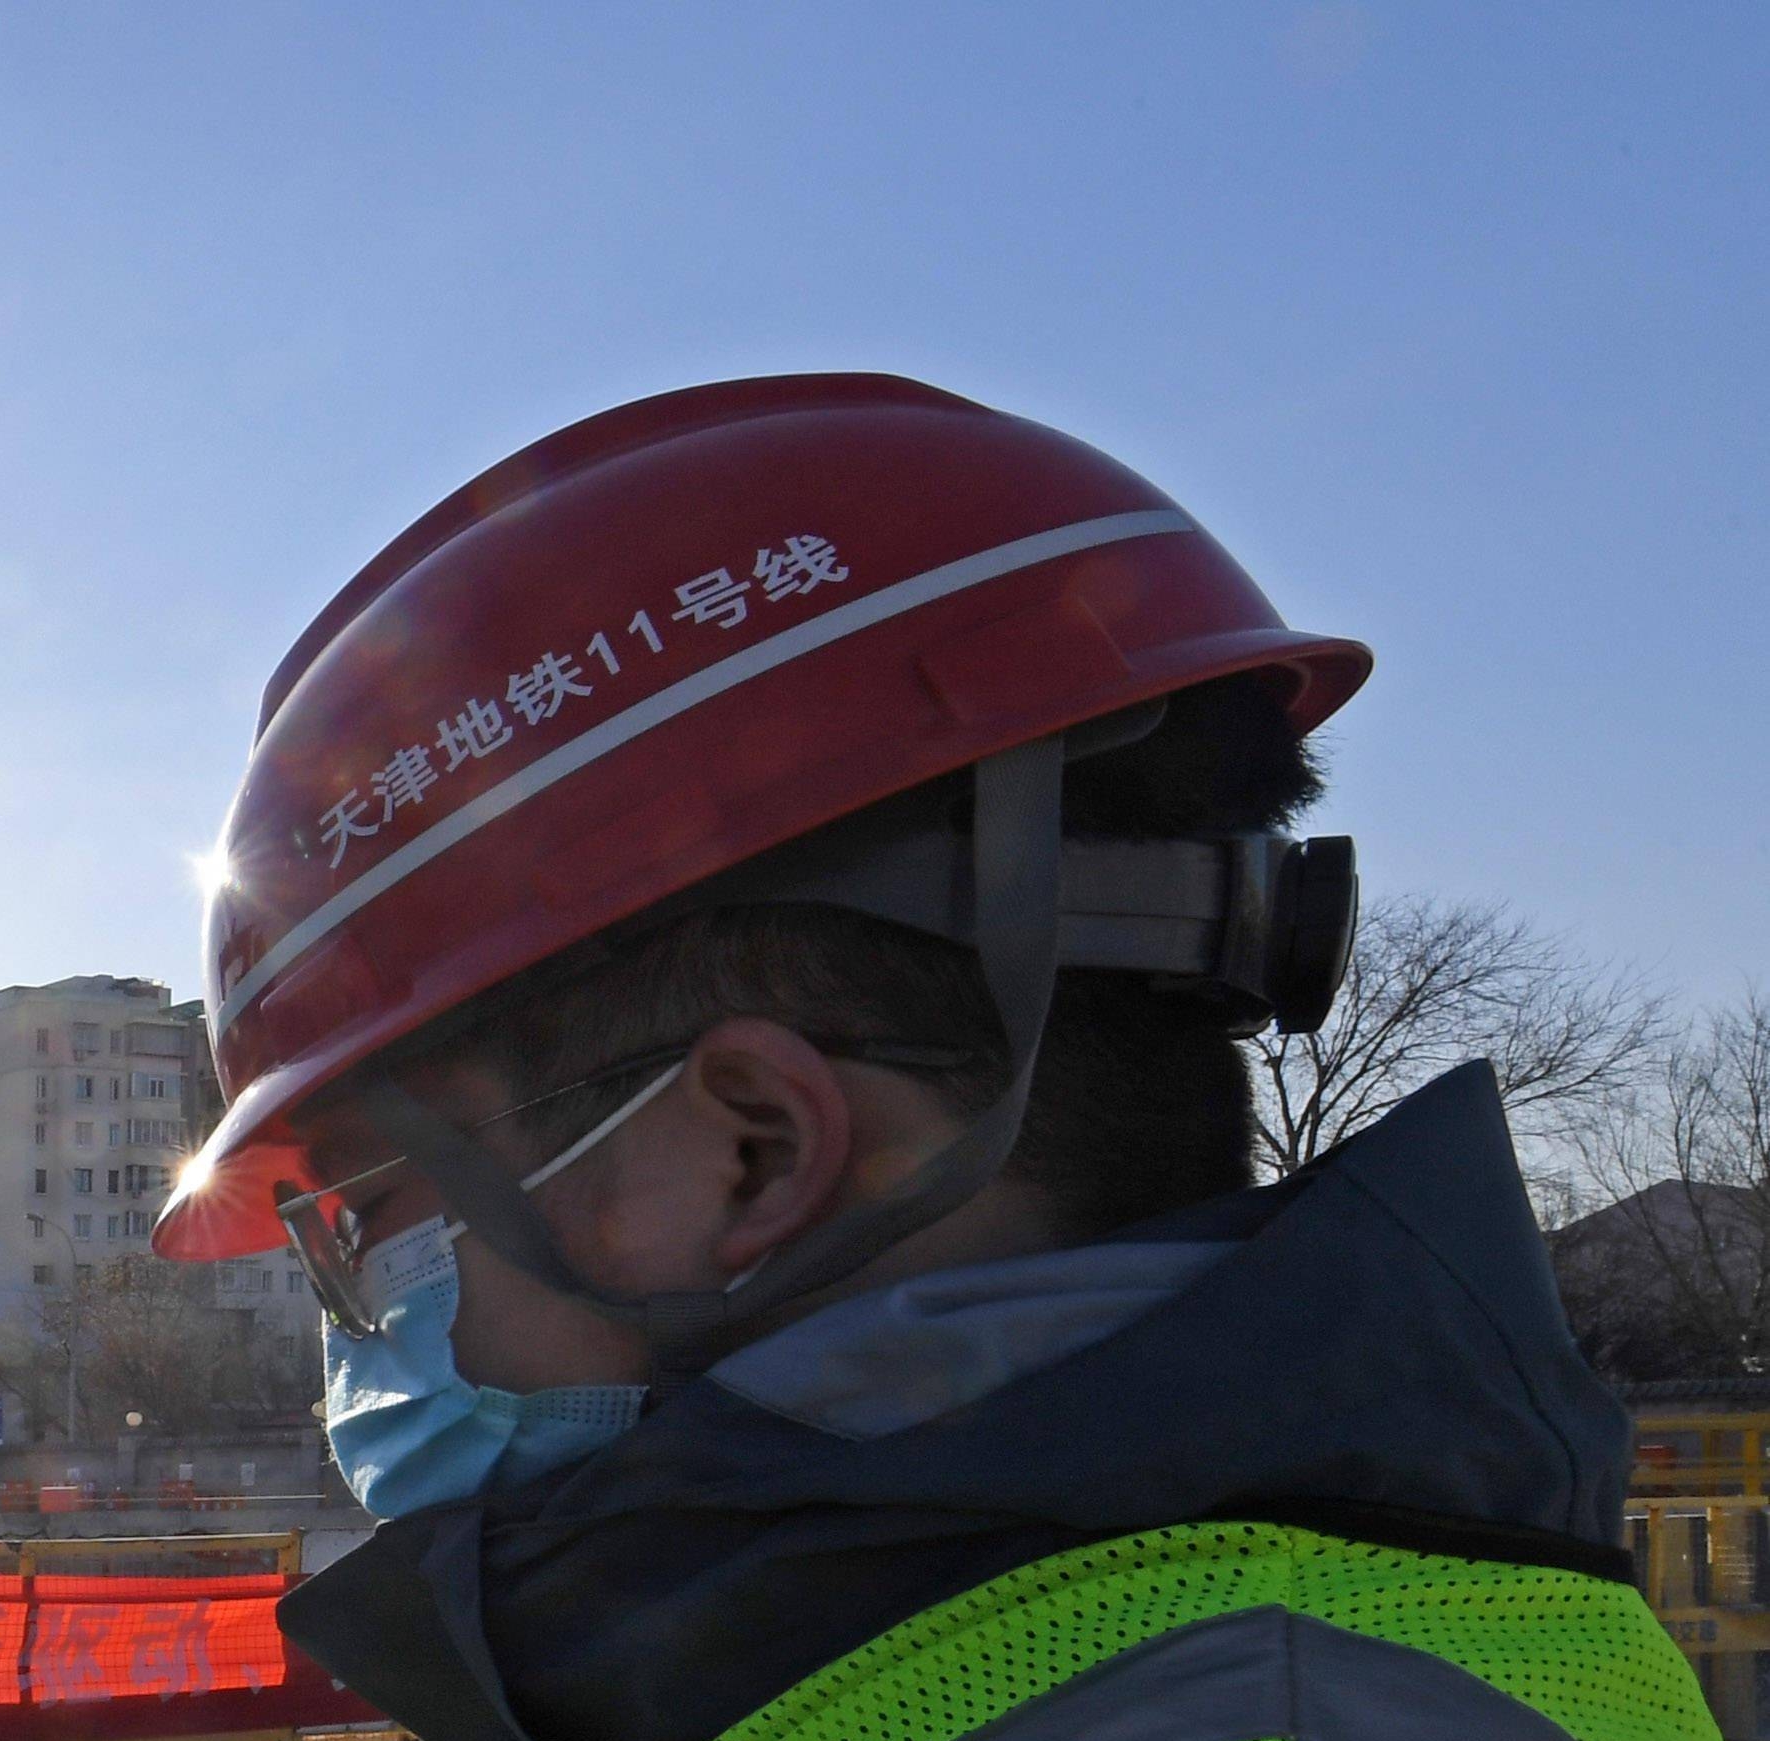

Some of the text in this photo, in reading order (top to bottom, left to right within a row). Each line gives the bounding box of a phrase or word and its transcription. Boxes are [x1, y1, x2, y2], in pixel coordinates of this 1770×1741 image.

[318, 533, 850, 869] 天津地铁11号线
